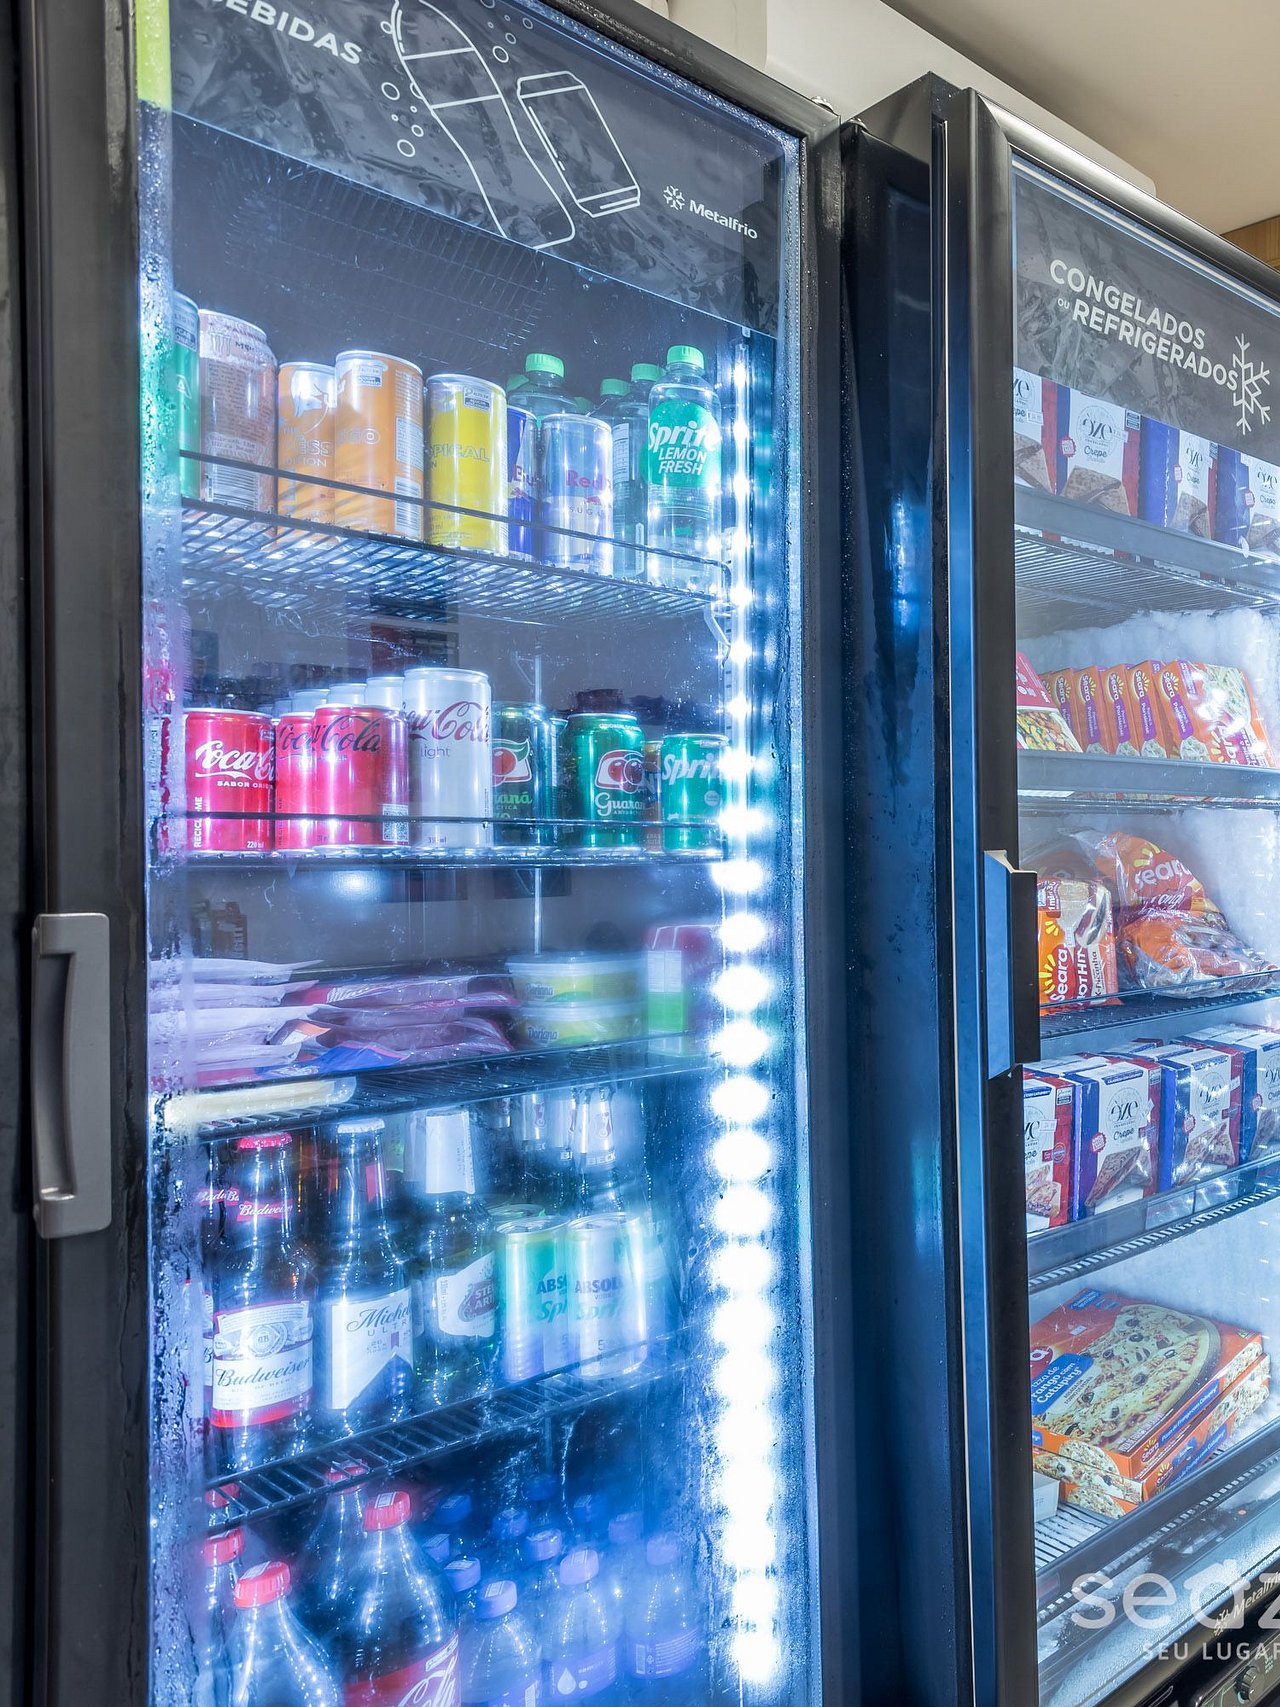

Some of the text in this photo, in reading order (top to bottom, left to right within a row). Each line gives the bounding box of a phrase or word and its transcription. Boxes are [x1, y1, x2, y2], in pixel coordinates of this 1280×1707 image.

[212, 0, 362, 64] EBIDAS
[688, 199, 758, 239] Metalfrio
[1050, 259, 1205, 350] CONGELADOS
[1072, 299, 1239, 391] REFRIGERADOS
[658, 447, 707, 463] LEMON
[658, 460, 704, 476] FRESH
[216, 780, 250, 788] SABOR
[661, 753, 719, 786] Spri
[194, 796, 203, 848] RECICL-ME
[594, 792, 646, 817] Guaran
[1050, 948, 1069, 1002] Seara
[575, 1279, 620, 1294] ABSOL
[367, 1319, 408, 1336] ULTR
[215, 1357, 311, 1388] Budweiser
[1031, 1374, 1060, 1398] rango
[1060, 1361, 1077, 1376] com
[1036, 1366, 1083, 1405] Catupiry
